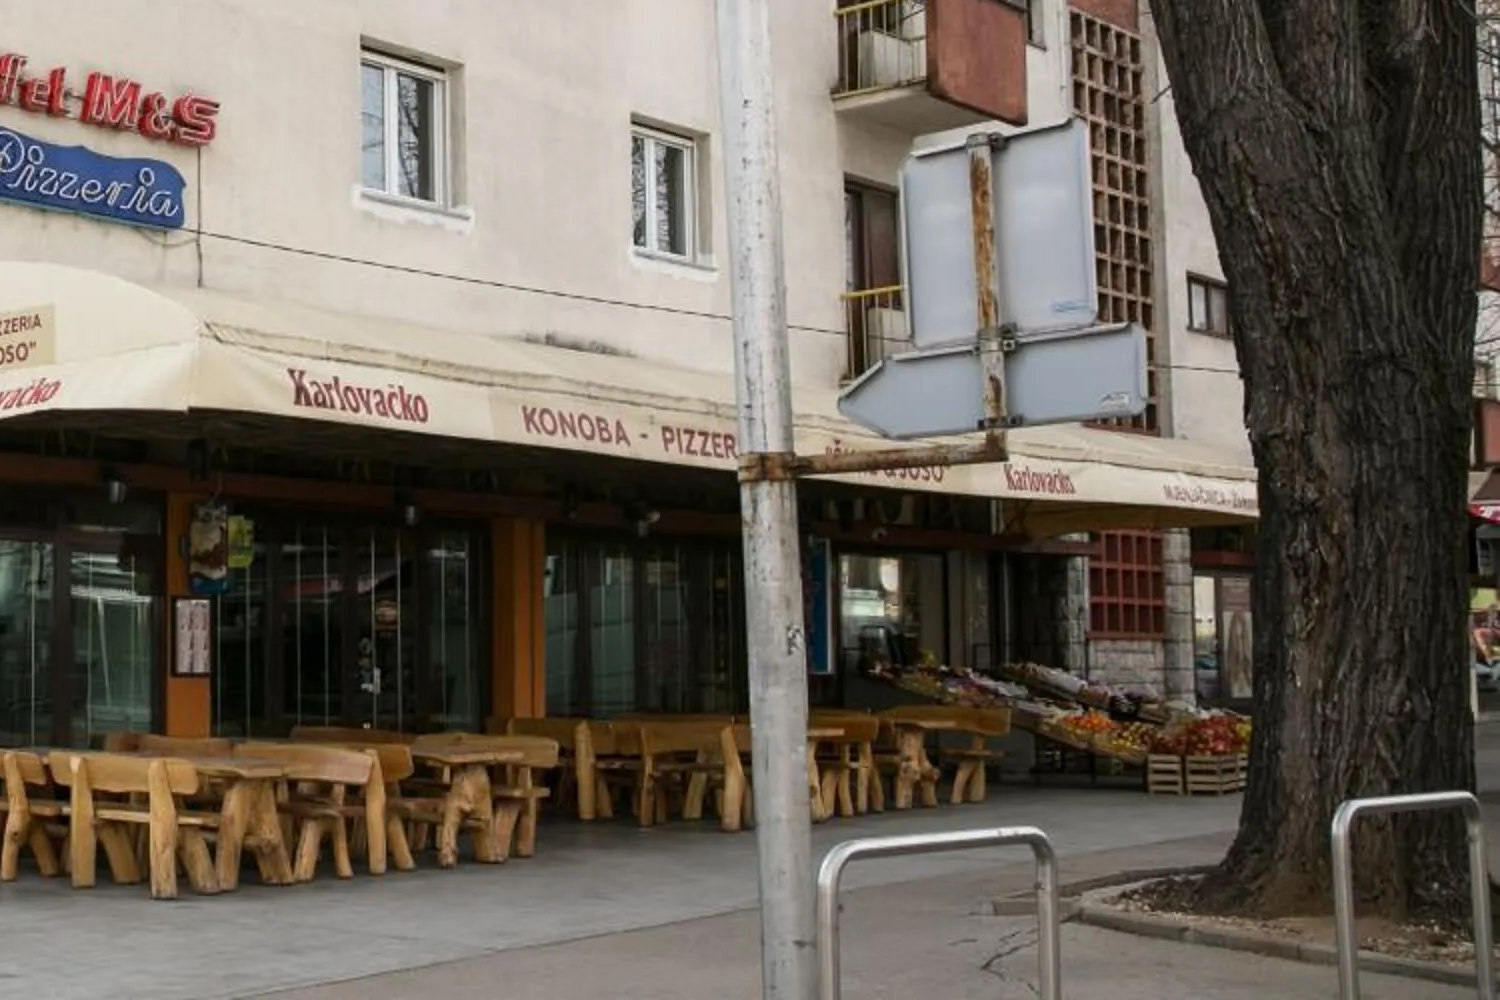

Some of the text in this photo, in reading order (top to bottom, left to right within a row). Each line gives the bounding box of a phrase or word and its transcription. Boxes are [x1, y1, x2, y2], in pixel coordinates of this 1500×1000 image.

[80, 71, 221, 147] M&S
[287, 368, 429, 424] Karlovačko
[521, 405, 631, 447] KONOBA
[661, 425, 740, 460] PIZZER
